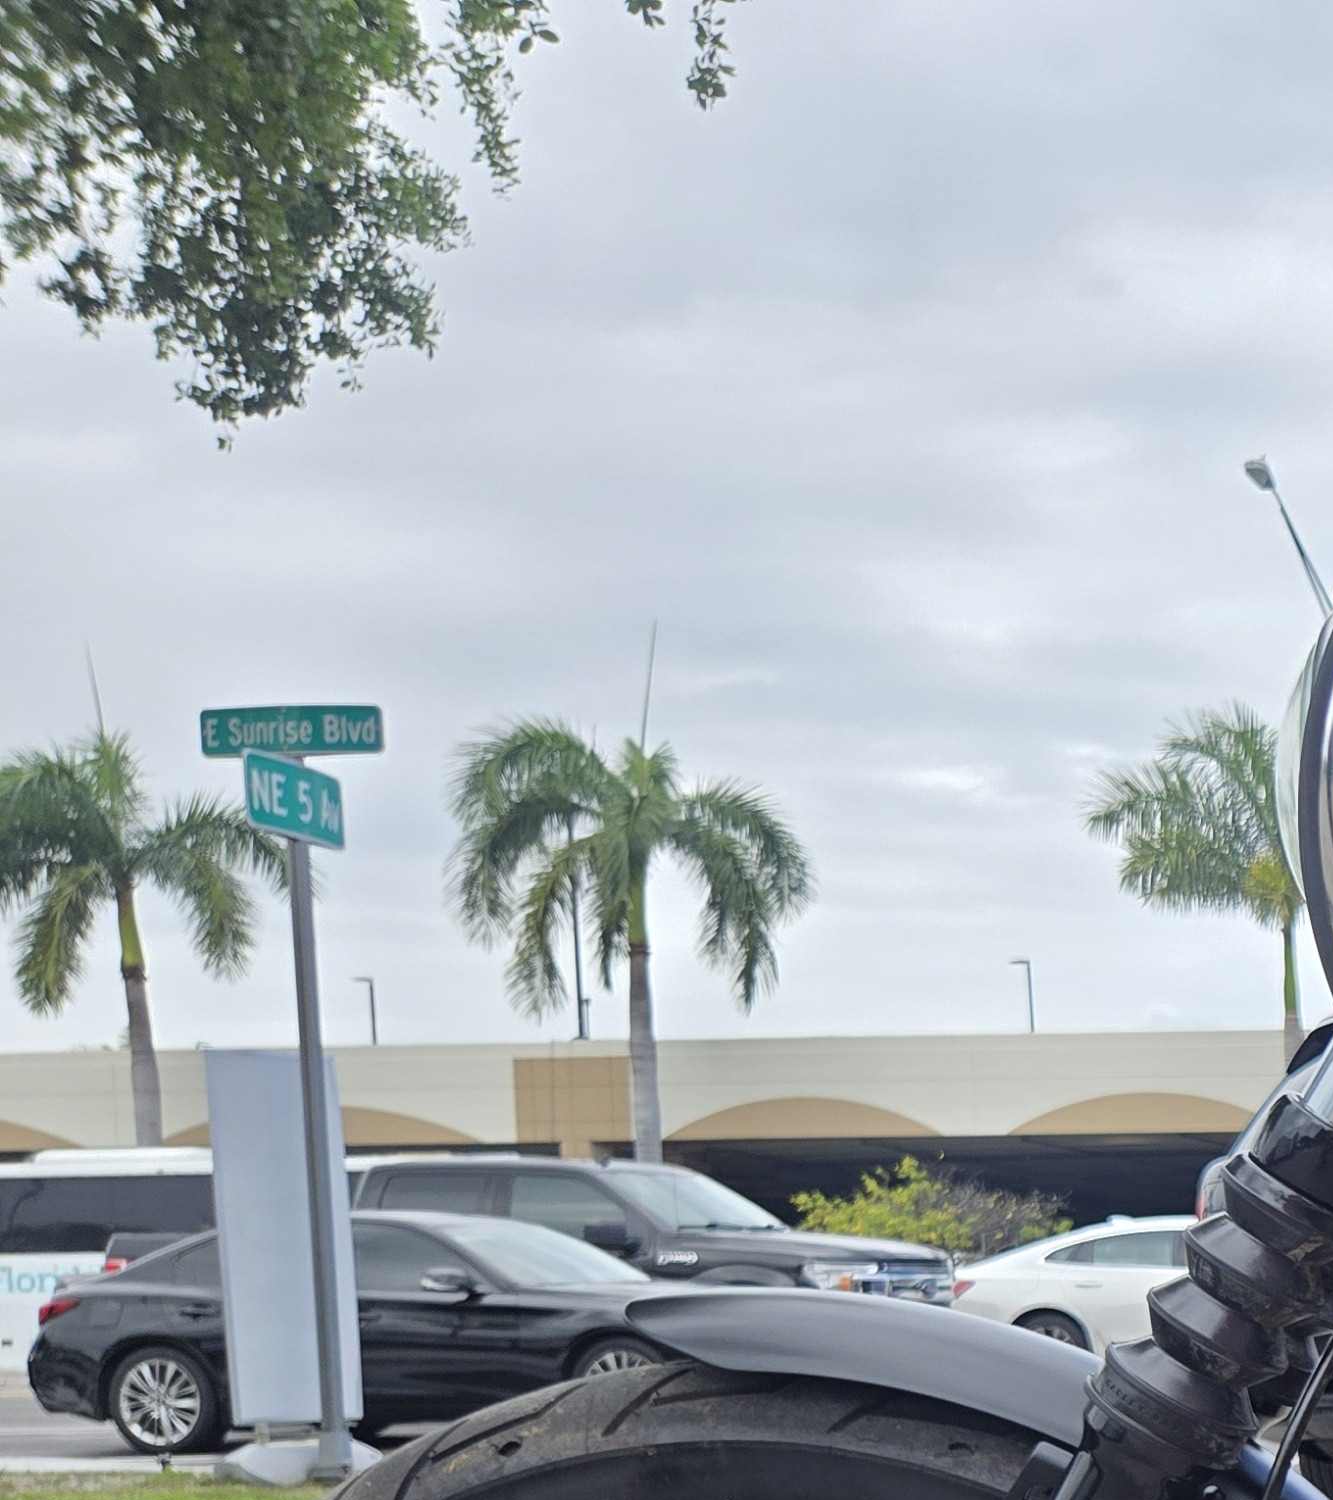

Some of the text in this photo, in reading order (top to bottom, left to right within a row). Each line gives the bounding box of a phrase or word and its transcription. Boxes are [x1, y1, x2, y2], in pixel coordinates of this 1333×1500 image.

[205, 714, 377, 748] E Sunrise Blvd
[250, 767, 288, 818] NE
[298, 780, 313, 824] 5
